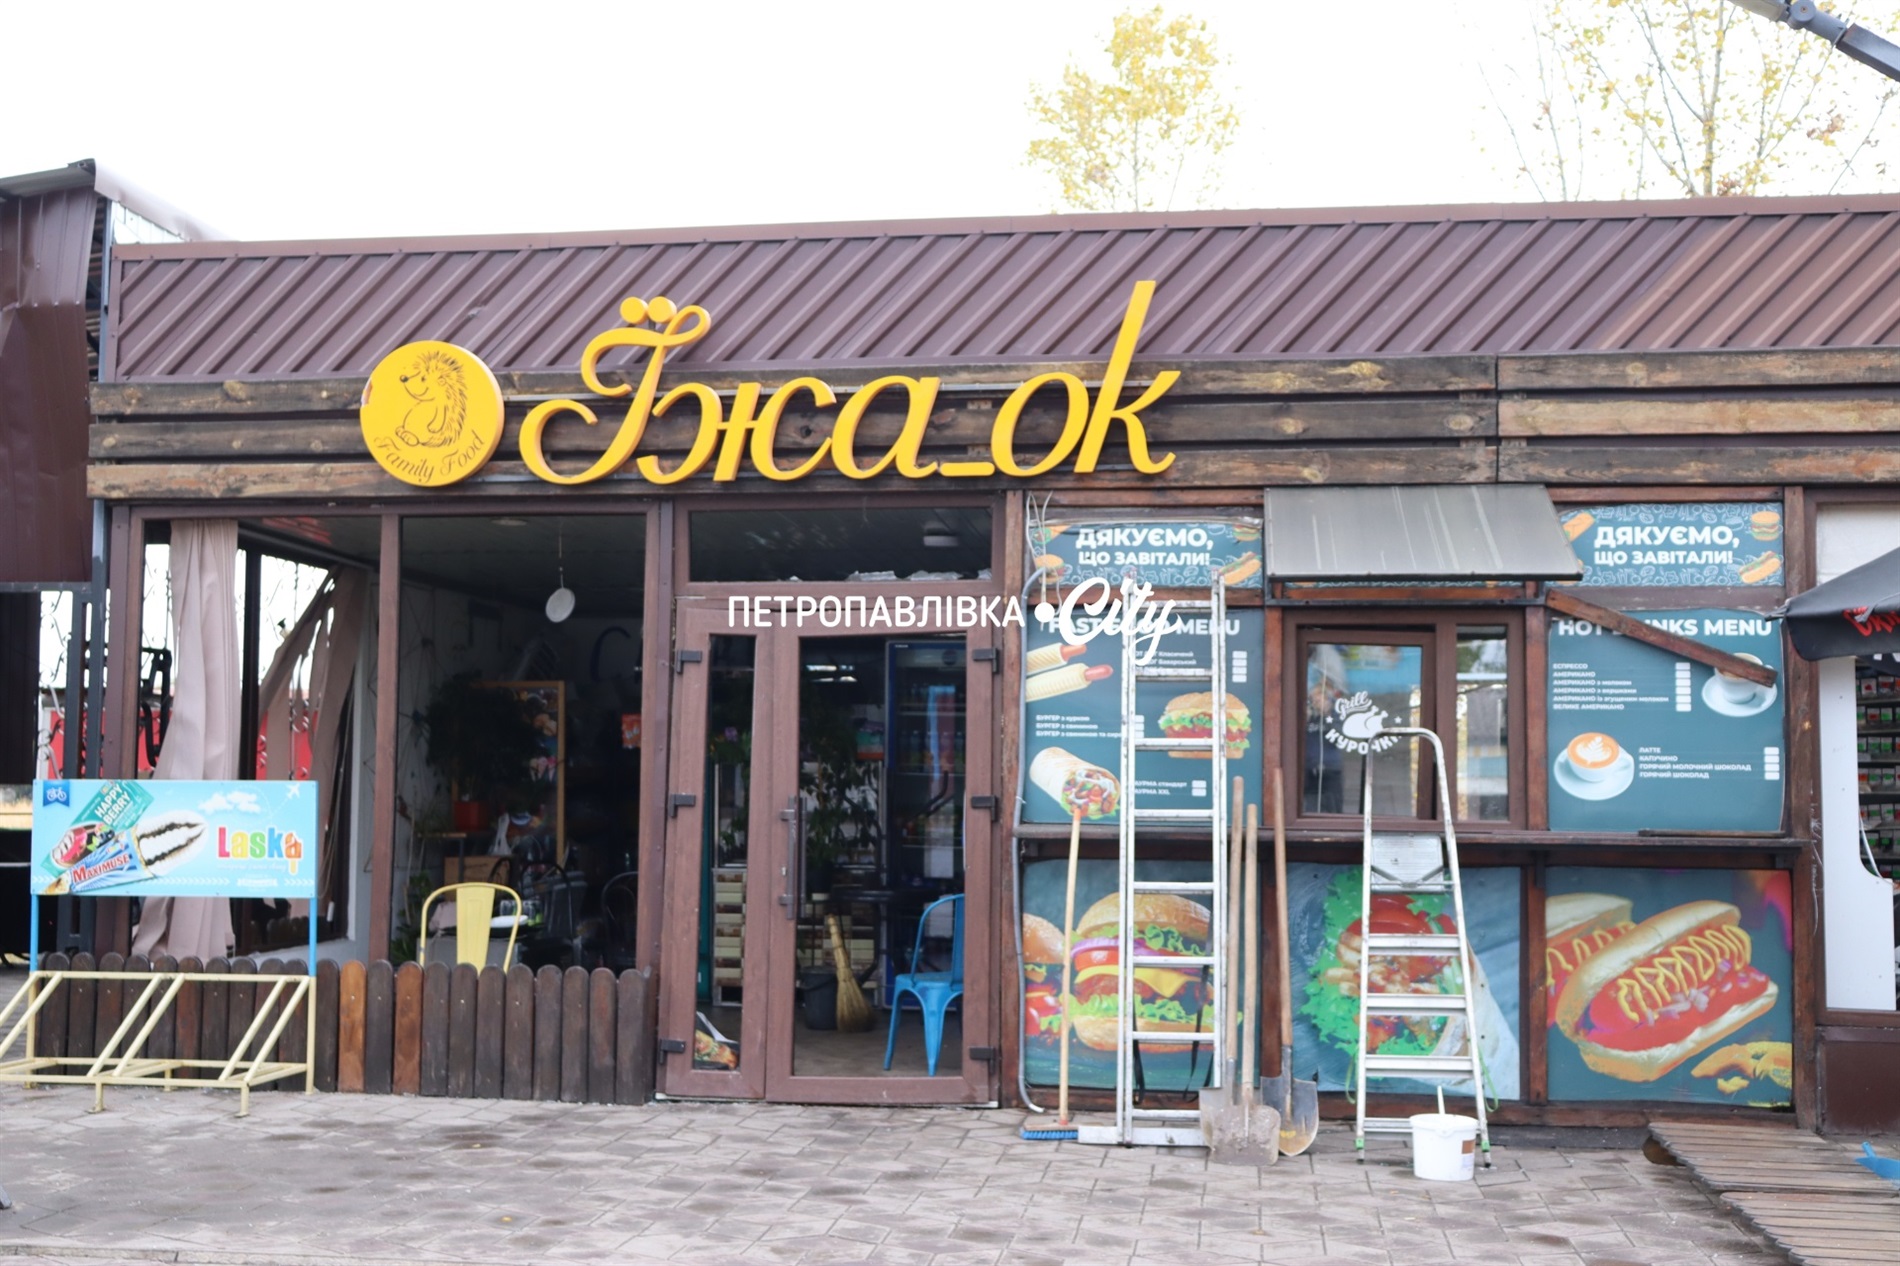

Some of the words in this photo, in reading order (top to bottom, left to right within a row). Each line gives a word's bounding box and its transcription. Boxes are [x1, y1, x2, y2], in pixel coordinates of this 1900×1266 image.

[373, 436, 435, 484] Family
[440, 429, 485, 476] Food
[1075, 528, 1214, 551] ДЯКУЄМО,
[1594, 525, 1740, 549] ДЯКУЄМО,
[1078, 551, 1111, 569] ЩО
[1114, 551, 1211, 567] ЗАВІТАЛИ!
[1594, 551, 1628, 568] ЩО
[1632, 550, 1734, 566] ЗАВІТАЛИ!
[1176, 618, 1241, 636] MEU
[1703, 618, 1773, 636] MENU
[1335, 690, 1373, 721] Grill
[94, 783, 123, 817] HAPPY
[103, 790, 131, 825] BERRY
[217, 826, 303, 860] Laska
